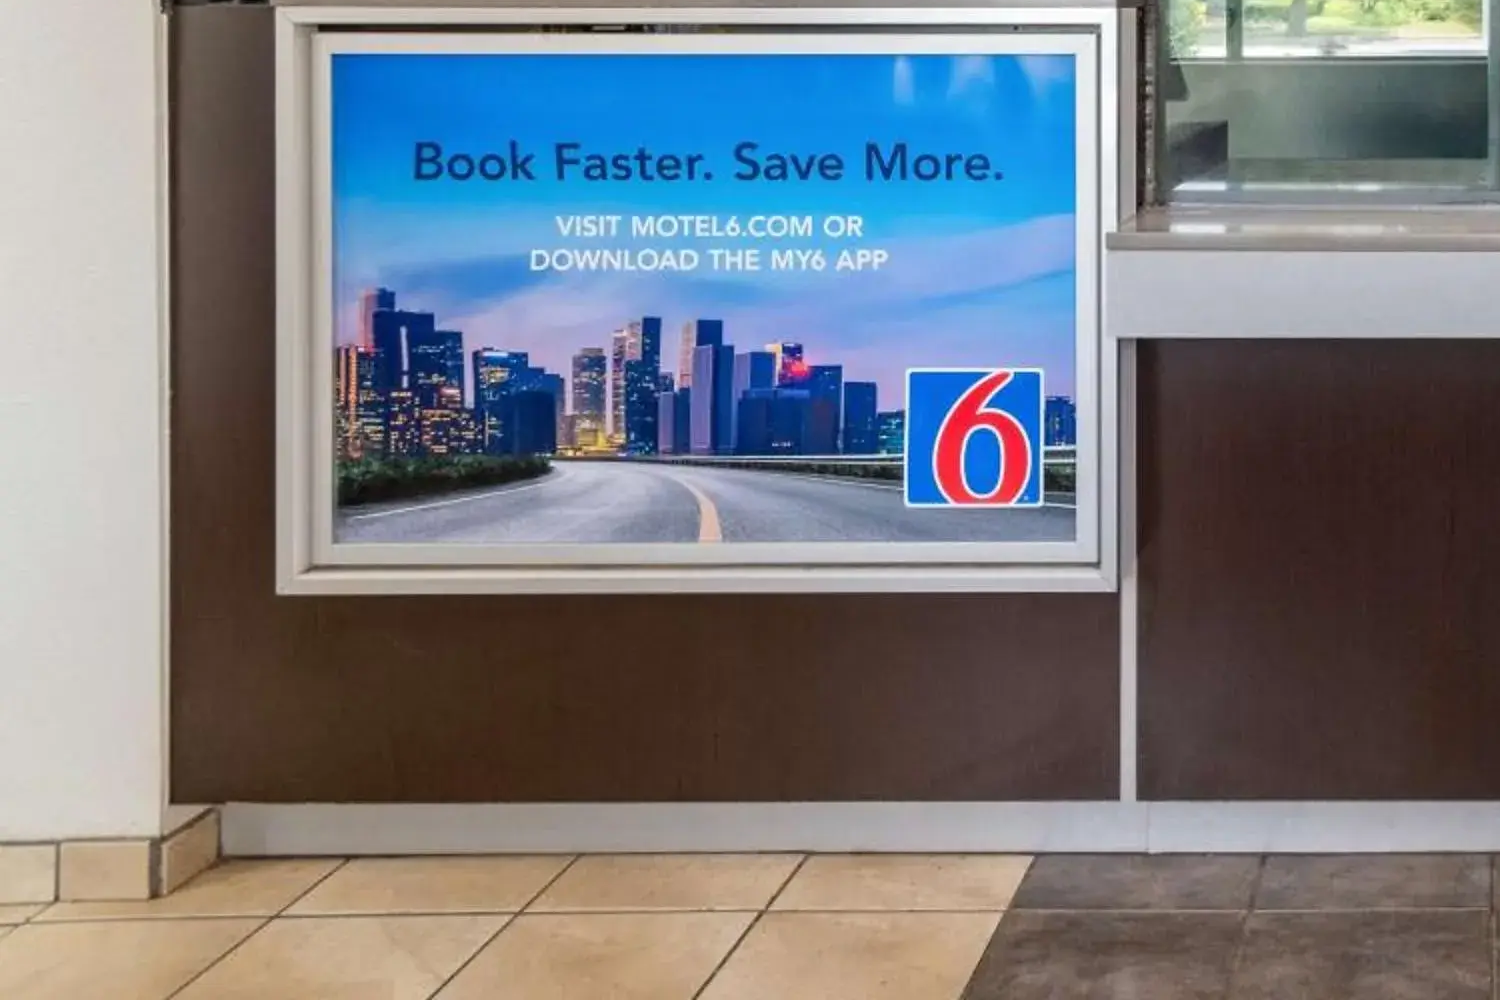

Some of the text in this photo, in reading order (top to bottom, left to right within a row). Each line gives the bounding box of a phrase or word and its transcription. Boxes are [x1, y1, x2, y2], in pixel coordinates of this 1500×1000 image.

[413, 140, 1005, 183] Book Faster. Save More.
[555, 215, 863, 238] VISIT MOTEL6.COM OR
[529, 249, 889, 272] DOWNLOAD THE MY6 APP
[932, 369, 1032, 507] 6
